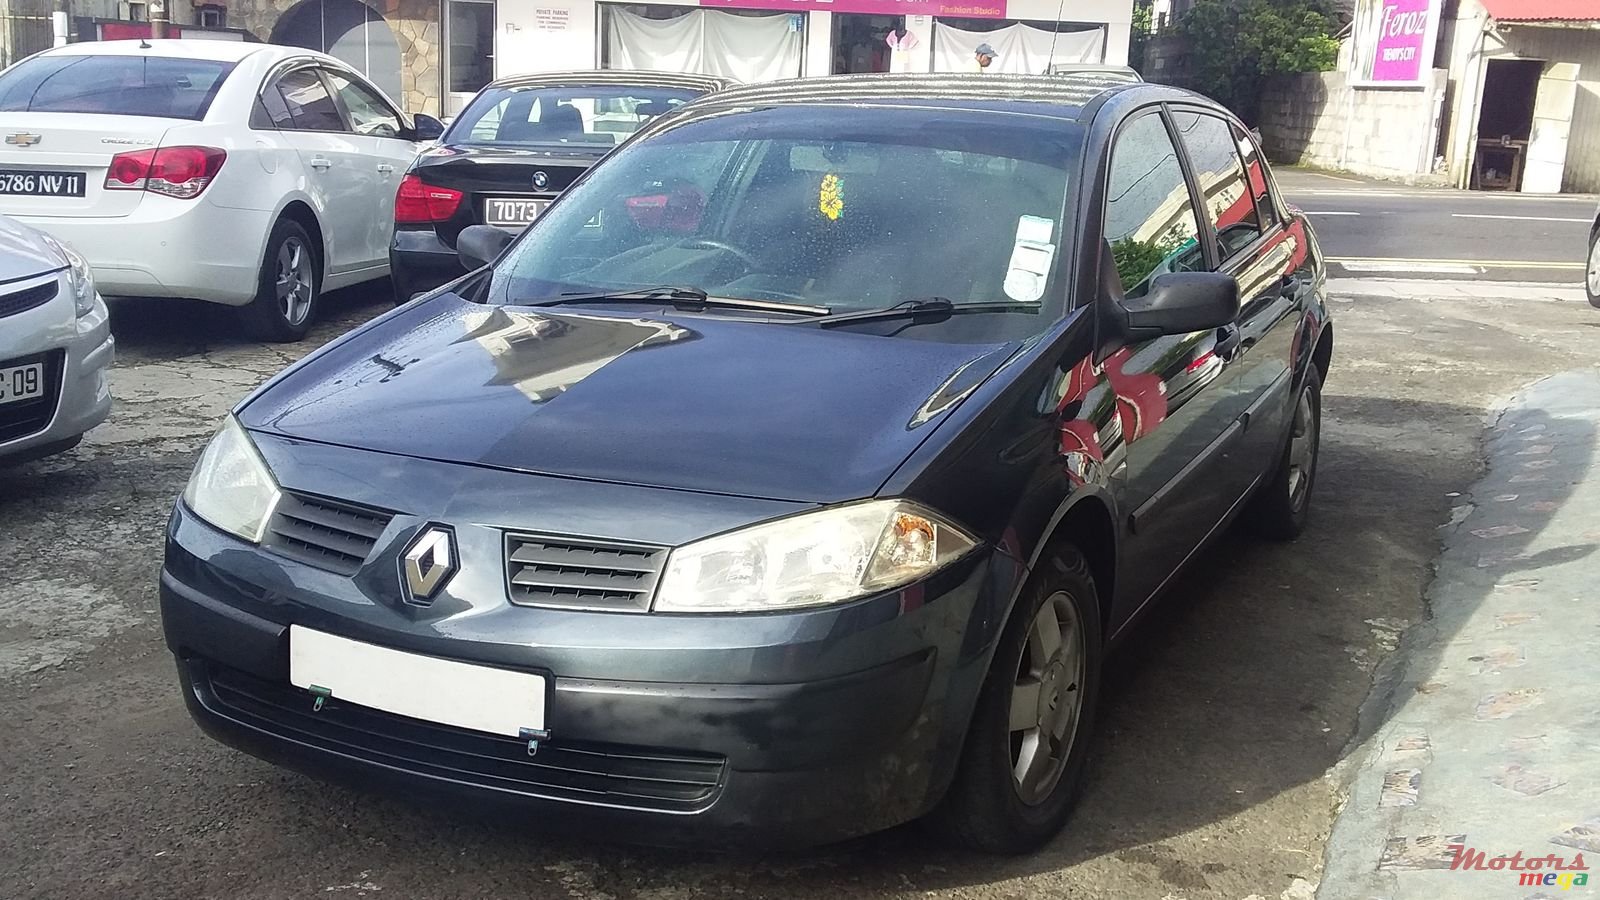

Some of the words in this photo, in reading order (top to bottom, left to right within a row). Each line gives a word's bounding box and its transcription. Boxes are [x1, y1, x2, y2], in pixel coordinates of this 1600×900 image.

[940, 5, 971, 14] Fashion
[974, 6, 1001, 15] Studio
[1380, 5, 1428, 41] Feroz
[38, 175, 63, 194] NV
[66, 176, 78, 194] 11
[494, 201, 537, 221] 7073
[13, 367, 38, 397] 09
